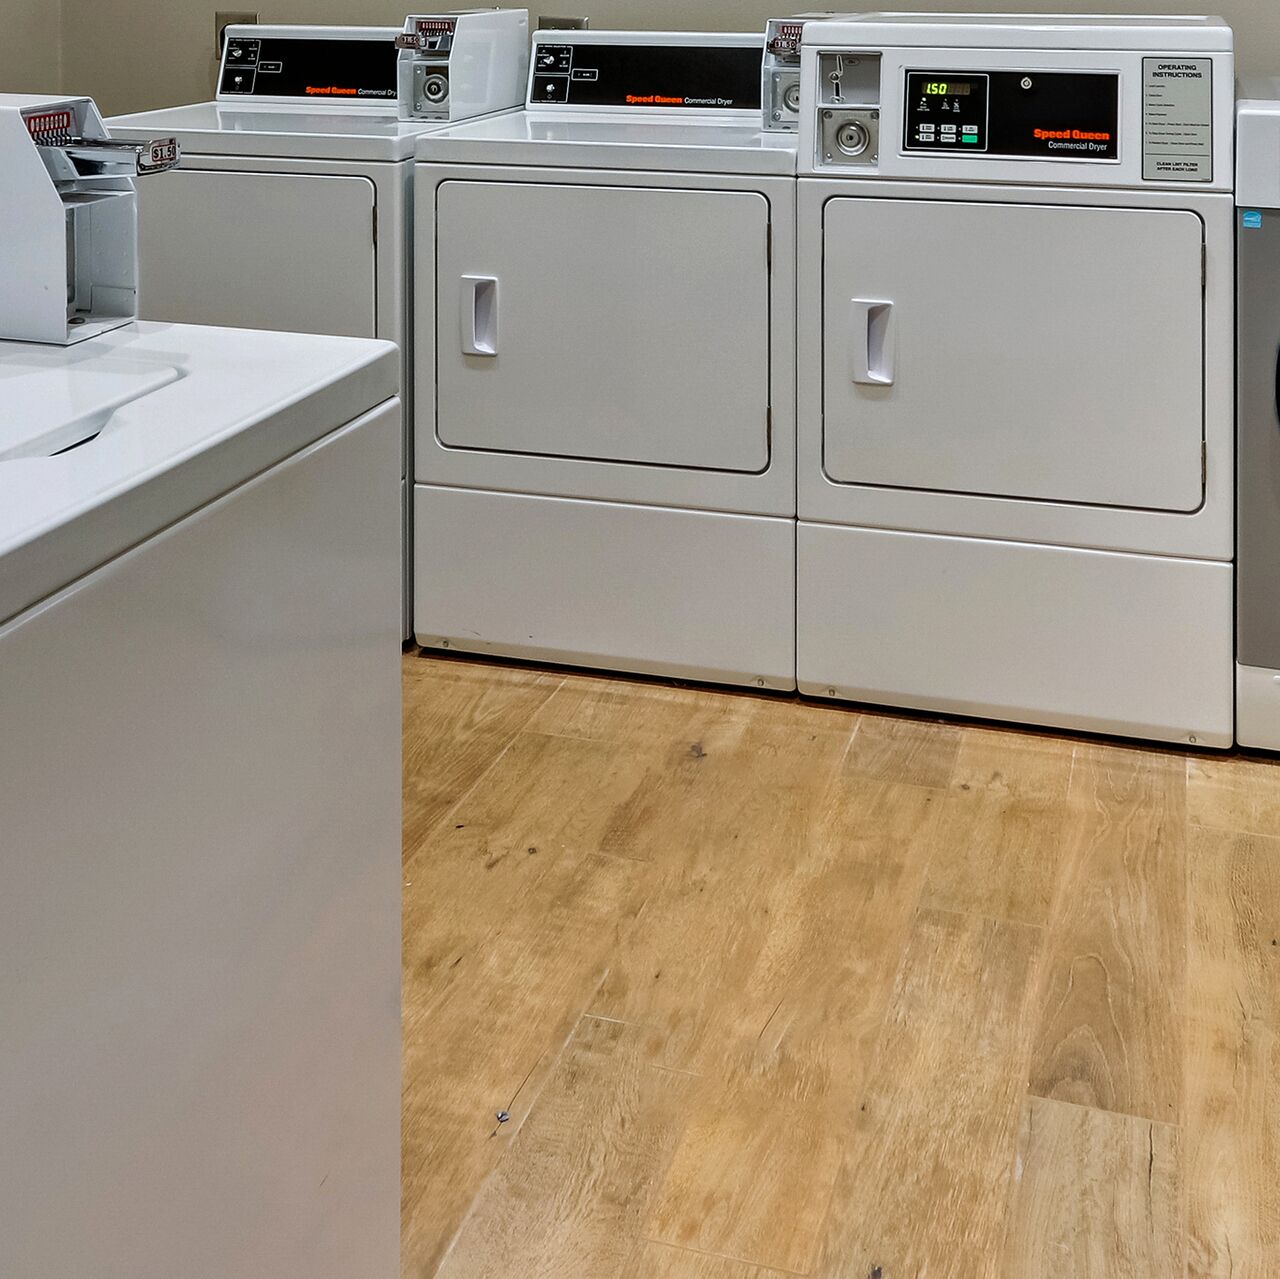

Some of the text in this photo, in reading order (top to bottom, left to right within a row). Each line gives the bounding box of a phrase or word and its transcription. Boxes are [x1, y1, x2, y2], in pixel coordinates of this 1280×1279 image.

[305, 86, 397, 97] Speed Queen Commercial Dry
[626, 95, 733, 106] Speed Queen Commercial Dryer
[1033, 128, 1110, 140] Speed Queen
[1048, 141, 1108, 152] Commercial Dryer
